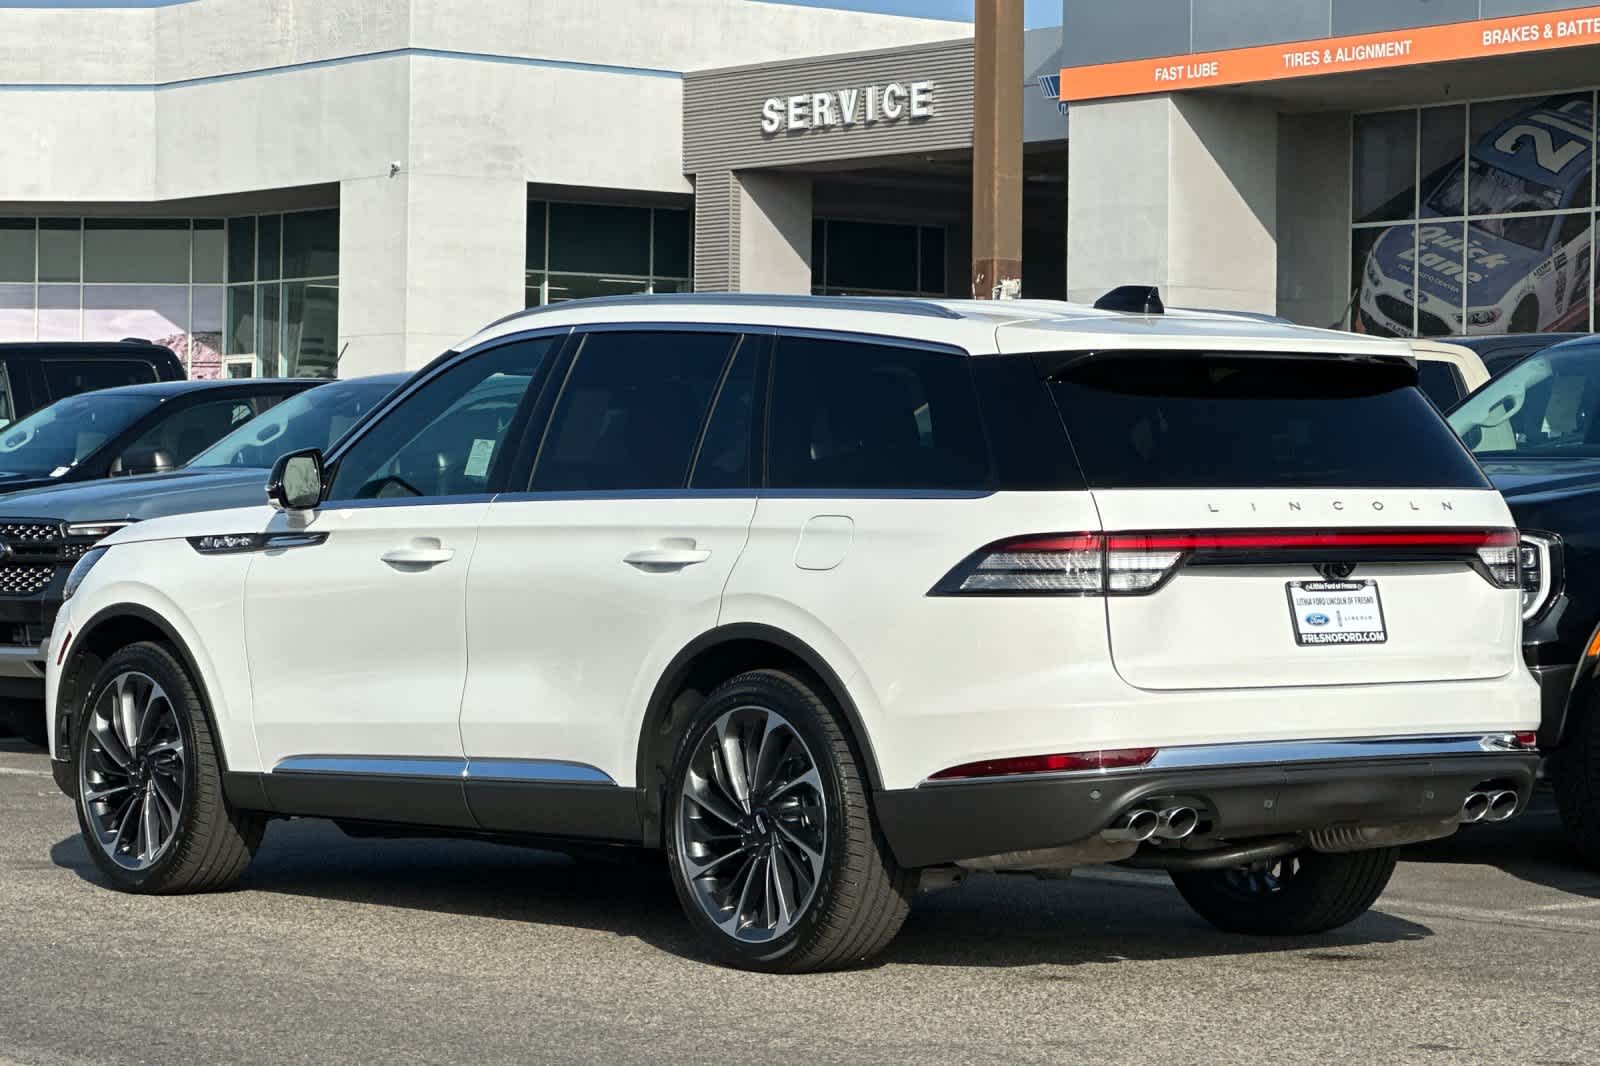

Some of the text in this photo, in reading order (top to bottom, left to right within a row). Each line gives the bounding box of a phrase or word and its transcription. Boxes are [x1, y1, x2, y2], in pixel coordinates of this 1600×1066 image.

[1482, 17, 1600, 46] BRAKES & BATTE
[1282, 40, 1413, 68] TIRES & ALIGNMENT
[1154, 62, 1219, 81] FAST LUBE
[761, 80, 934, 133] SERVICE
[1207, 500, 1453, 512] LINCOLN
[1301, 631, 1385, 643] FRESNOFORD.COM
